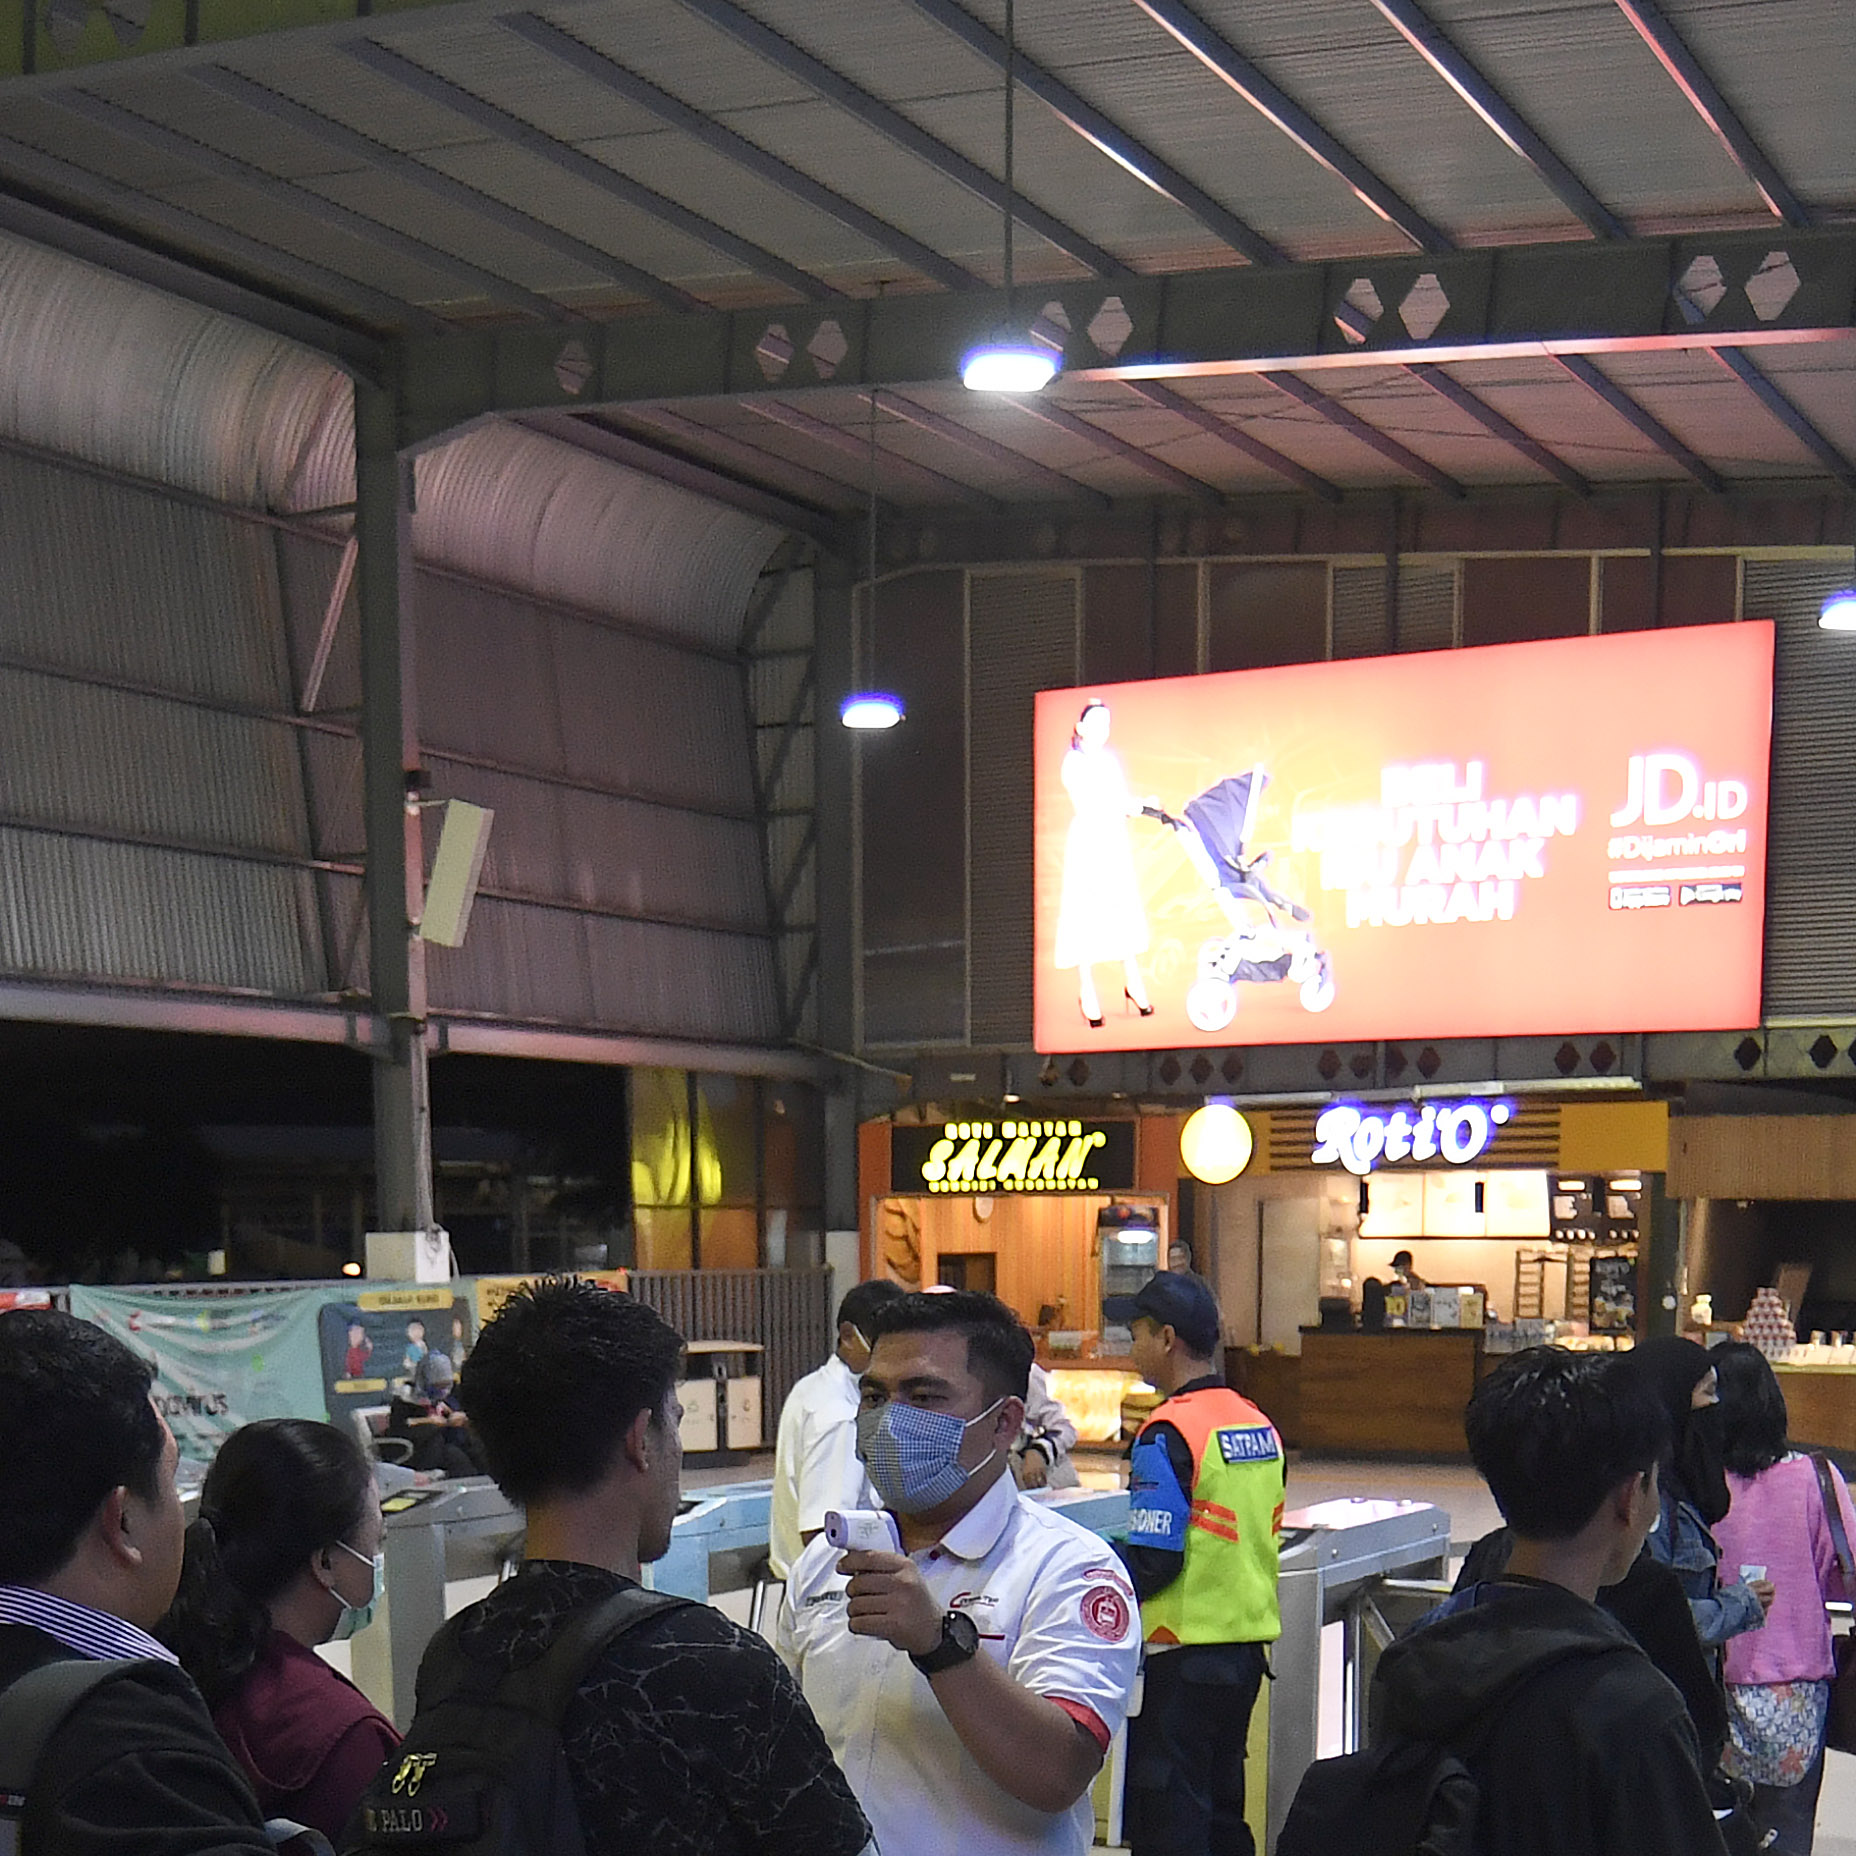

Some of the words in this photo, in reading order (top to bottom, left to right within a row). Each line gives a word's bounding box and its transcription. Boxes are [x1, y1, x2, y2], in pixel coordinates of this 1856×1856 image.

[1609, 754, 1748, 828] JD.ID
[1405, 837, 1545, 886] ANAK
[1346, 880, 1515, 928] MURAH
[1220, 1427, 1277, 1459] SATPAM
